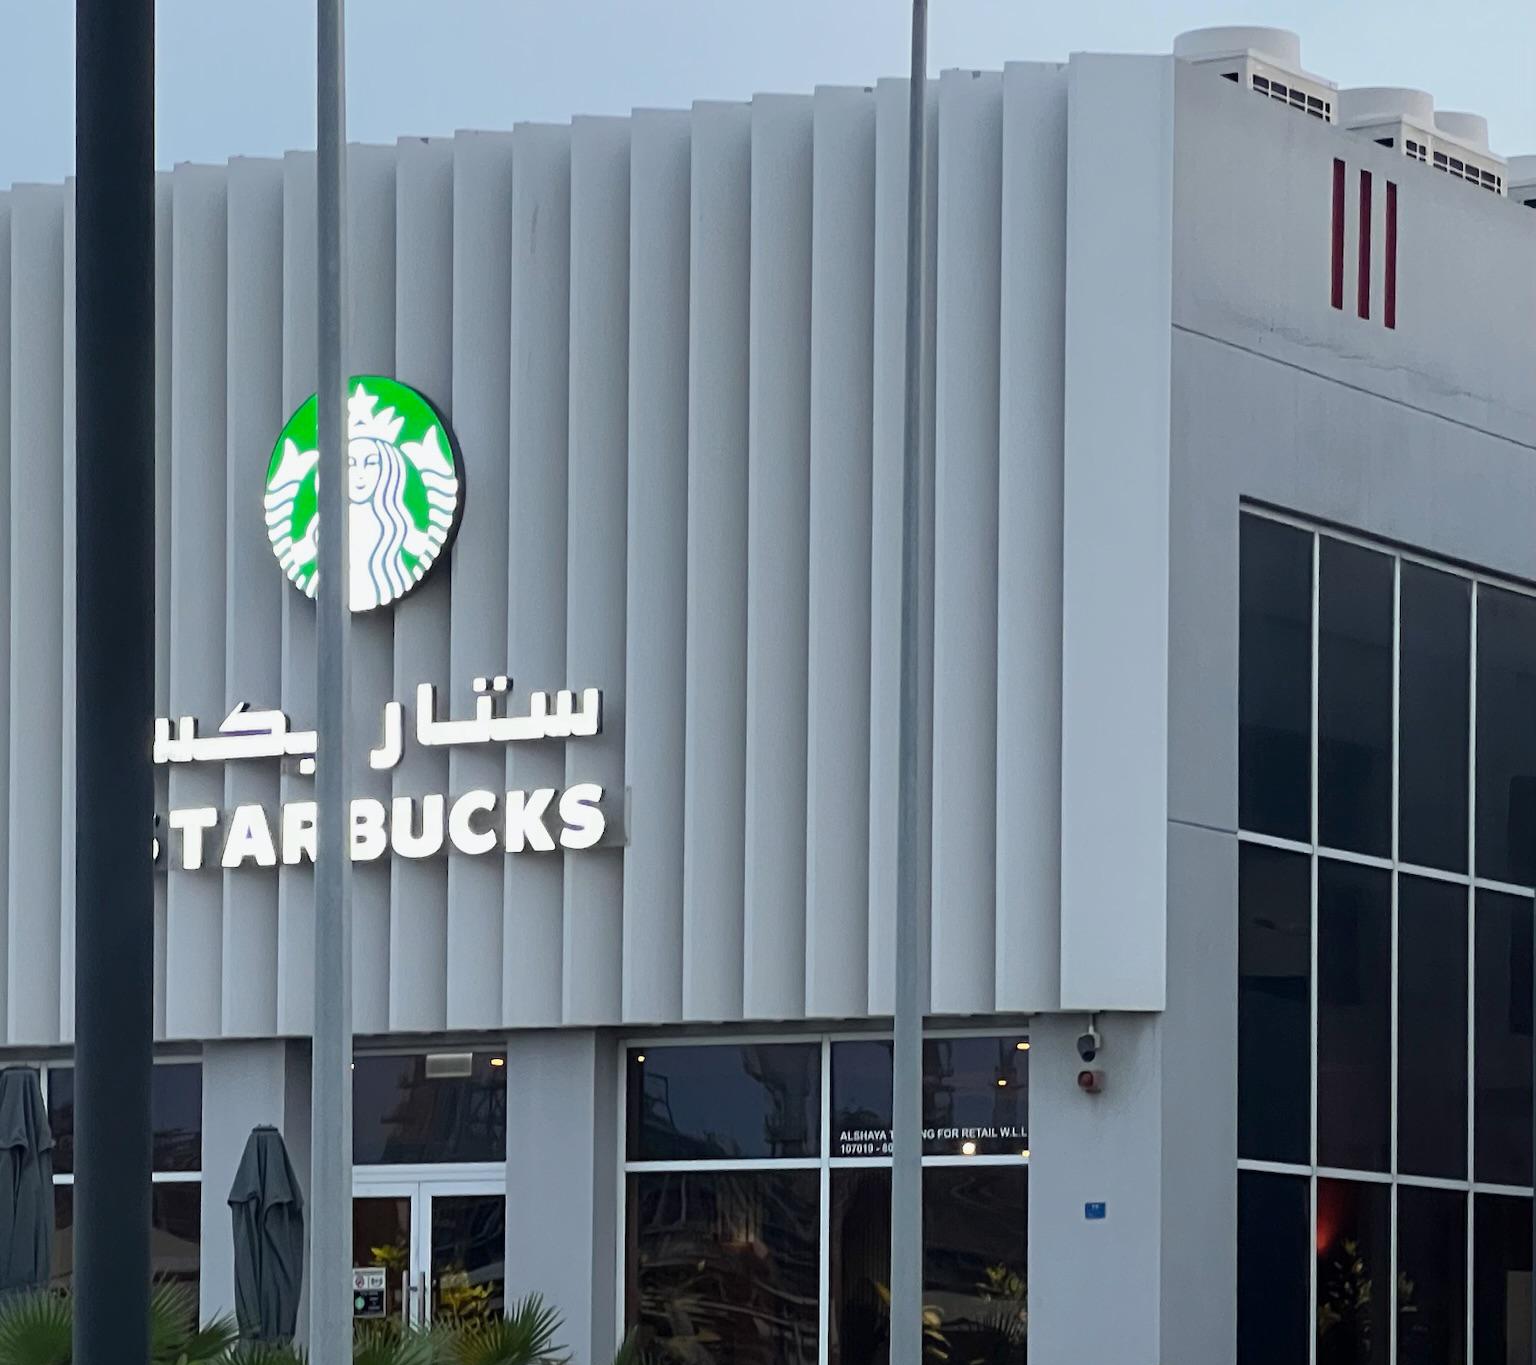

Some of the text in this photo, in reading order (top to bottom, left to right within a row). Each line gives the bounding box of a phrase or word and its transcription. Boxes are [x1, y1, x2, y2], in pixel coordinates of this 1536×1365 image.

[370, 676, 599, 769] ستار
[153, 783, 605, 869] TARBUCKS
[840, 1130, 887, 1140] ALSHAYA
[937, 1128, 958, 1139] FOR
[962, 1127, 997, 1138] RETAIL
